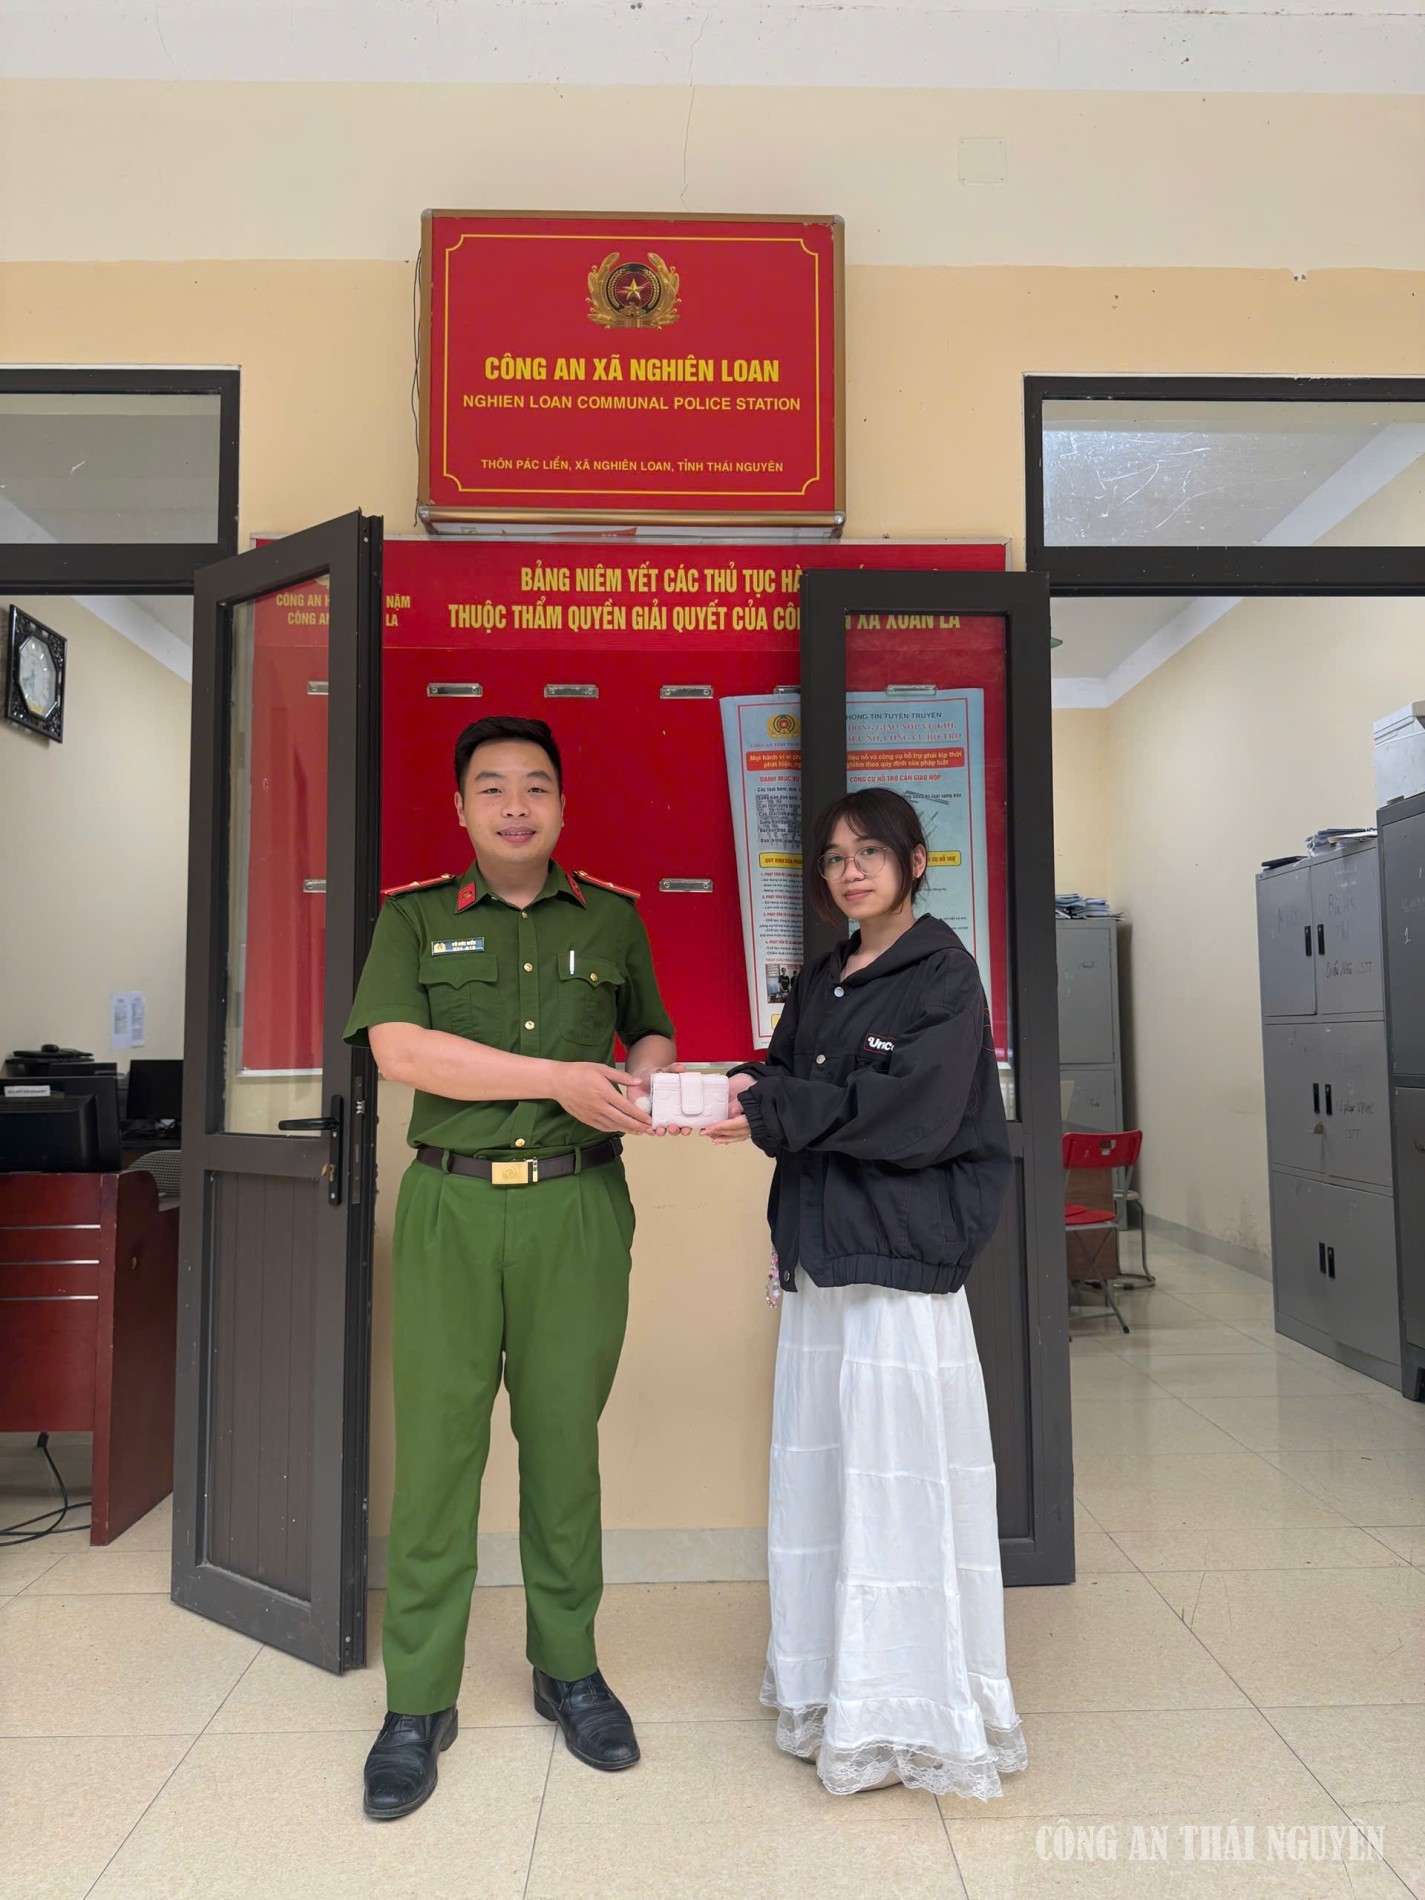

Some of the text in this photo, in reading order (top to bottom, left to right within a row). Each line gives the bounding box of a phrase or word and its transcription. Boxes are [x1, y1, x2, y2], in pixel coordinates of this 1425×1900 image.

[485, 352, 779, 382] CÔNG AN XÃ NGHIÊN LOAN
[463, 394, 800, 411] NGHIEN LOAN COMMUNAL POLICE STATION
[481, 457, 513, 470] THÔN
[516, 457, 540, 470] PÁC
[575, 458, 591, 470] XÃ
[593, 458, 637, 471] NGHIÊN
[640, 461, 674, 472] LOAN,
[678, 458, 703, 472] TỈNH
[707, 459, 732, 472] THÁI
[736, 460, 783, 472] NGUYÊN
[521, 559, 803, 598] BẢNG NIÊM YẾT CÁC THỦ TỤC HÀ
[276, 592, 304, 606] CÔNG
[307, 594, 321, 606] AN
[287, 609, 316, 625] CÔNG
[386, 613, 399, 626] LA
[448, 600, 507, 634] THUỘC
[512, 596, 562, 629] THẨM
[568, 598, 626, 632] QUYỀN
[631, 599, 667, 631] GIẢI
[673, 599, 727, 633] QUYẾT
[732, 599, 768, 631] CỦA
